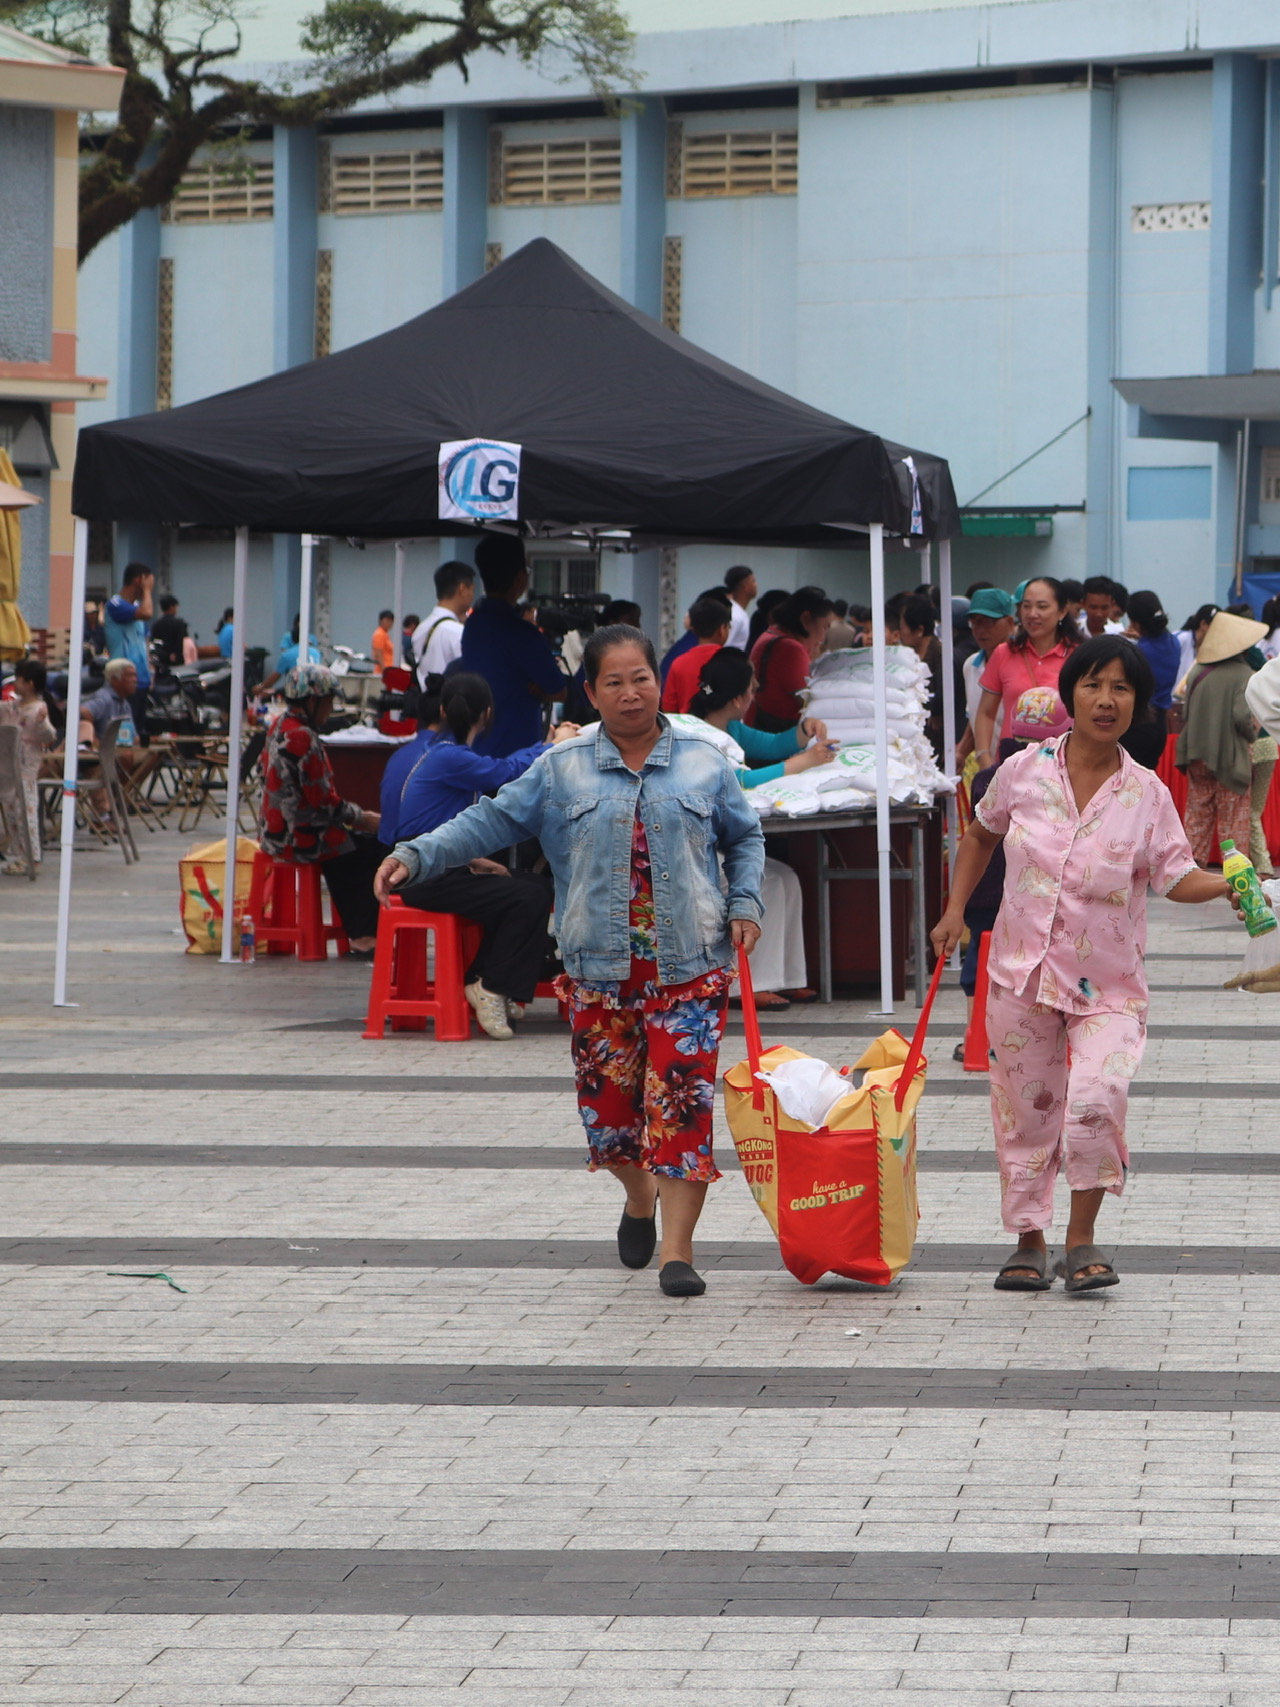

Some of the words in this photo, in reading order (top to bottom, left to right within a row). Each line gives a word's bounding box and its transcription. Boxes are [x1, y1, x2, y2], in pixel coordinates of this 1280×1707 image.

[790, 1194, 828, 1212] GOOD
[828, 1183, 868, 1205] TRIP
[812, 1180, 838, 1195] have
[838, 1180, 848, 1189] a
